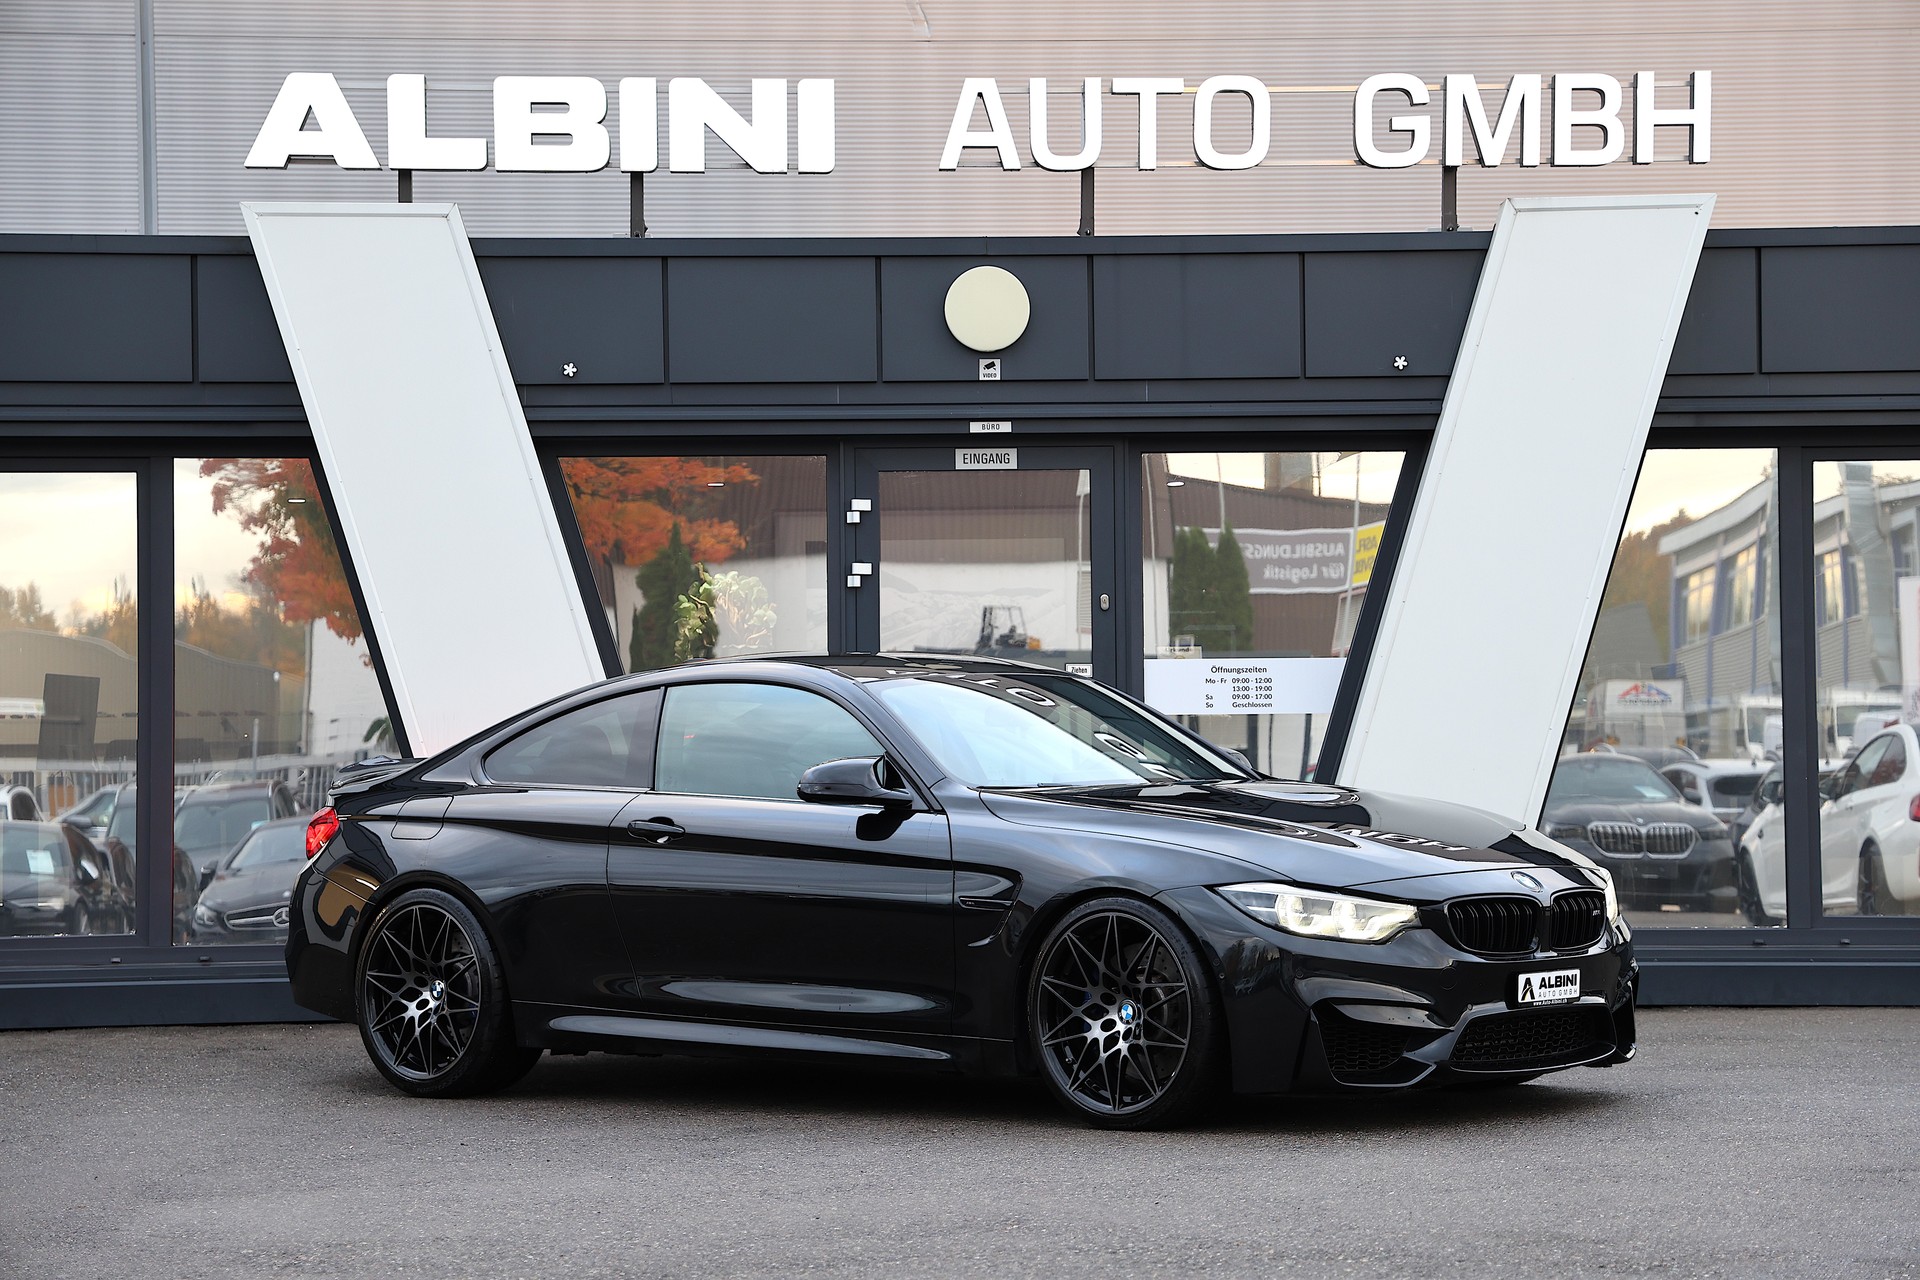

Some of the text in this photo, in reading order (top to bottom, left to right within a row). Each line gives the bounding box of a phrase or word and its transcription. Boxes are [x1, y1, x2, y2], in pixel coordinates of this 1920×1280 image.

[243, 69, 1713, 174] ALBINI AUTO GMBH
[981, 423, 1000, 431] BÜRO
[962, 452, 1011, 465] EINGANG
[1071, 666, 1088, 674] Ziehen
[1210, 665, 1268, 675] Öffnungszeiten
[1232, 701, 1273, 709] Geschlossen
[1538, 974, 1578, 990] ALBINI
[1538, 988, 1578, 998] AUTO GMBH
